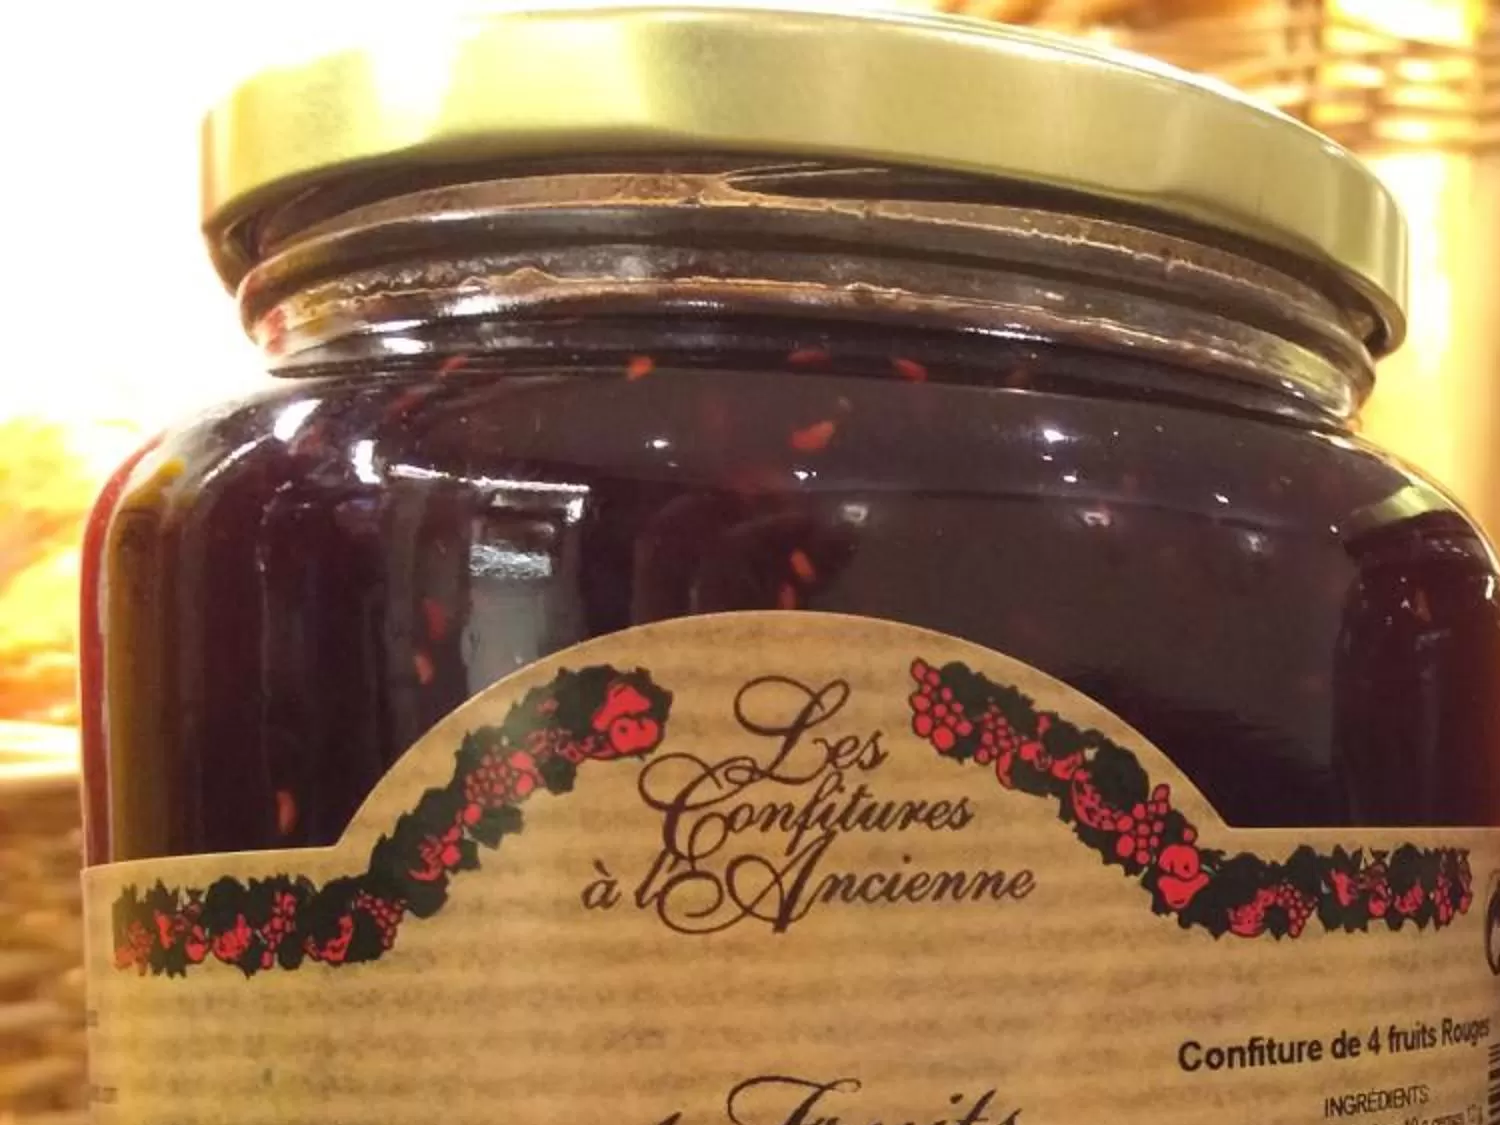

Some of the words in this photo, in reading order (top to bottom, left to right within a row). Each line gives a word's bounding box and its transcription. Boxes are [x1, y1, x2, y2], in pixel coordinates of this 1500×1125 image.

[733, 676, 890, 785] Les
[638, 752, 976, 862] Confitures
[581, 858, 622, 911] à
[1178, 1036, 1323, 1072] Confiture
[1331, 1029, 1361, 1060] de
[1367, 1026, 1381, 1056] 4
[1388, 1021, 1437, 1053] fruits
